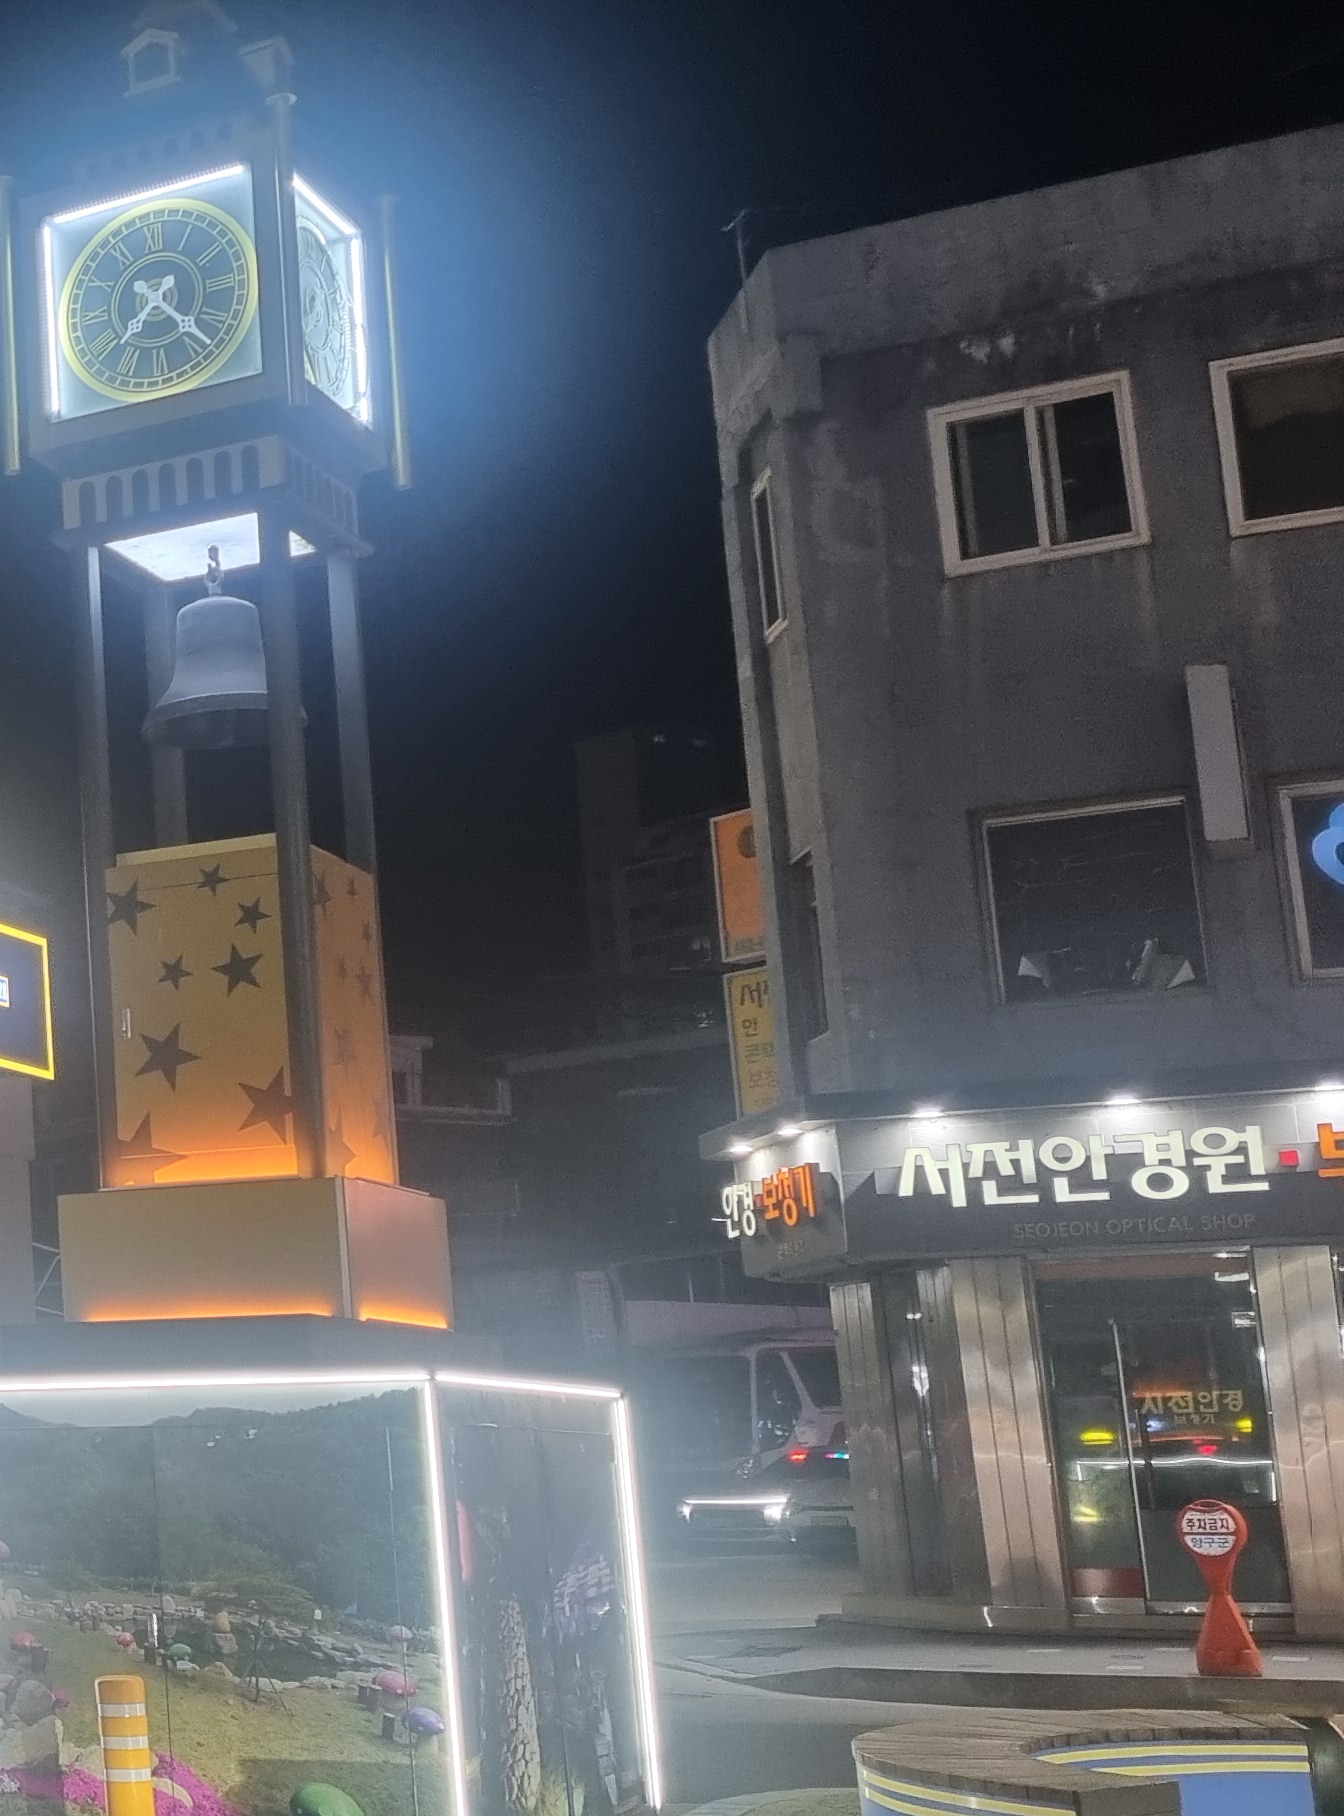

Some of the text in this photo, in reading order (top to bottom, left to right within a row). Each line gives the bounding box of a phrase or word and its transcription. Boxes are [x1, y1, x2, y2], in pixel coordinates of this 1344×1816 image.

[898, 1125, 1270, 1208] 서전안경원
[762, 1163, 815, 1226] 보청기
[1013, 1213, 1255, 1240] SEOJEON OPTICAL SHOP
[1185, 1517, 1230, 1531] 주차금지
[1191, 1537, 1231, 1549] 양구군
